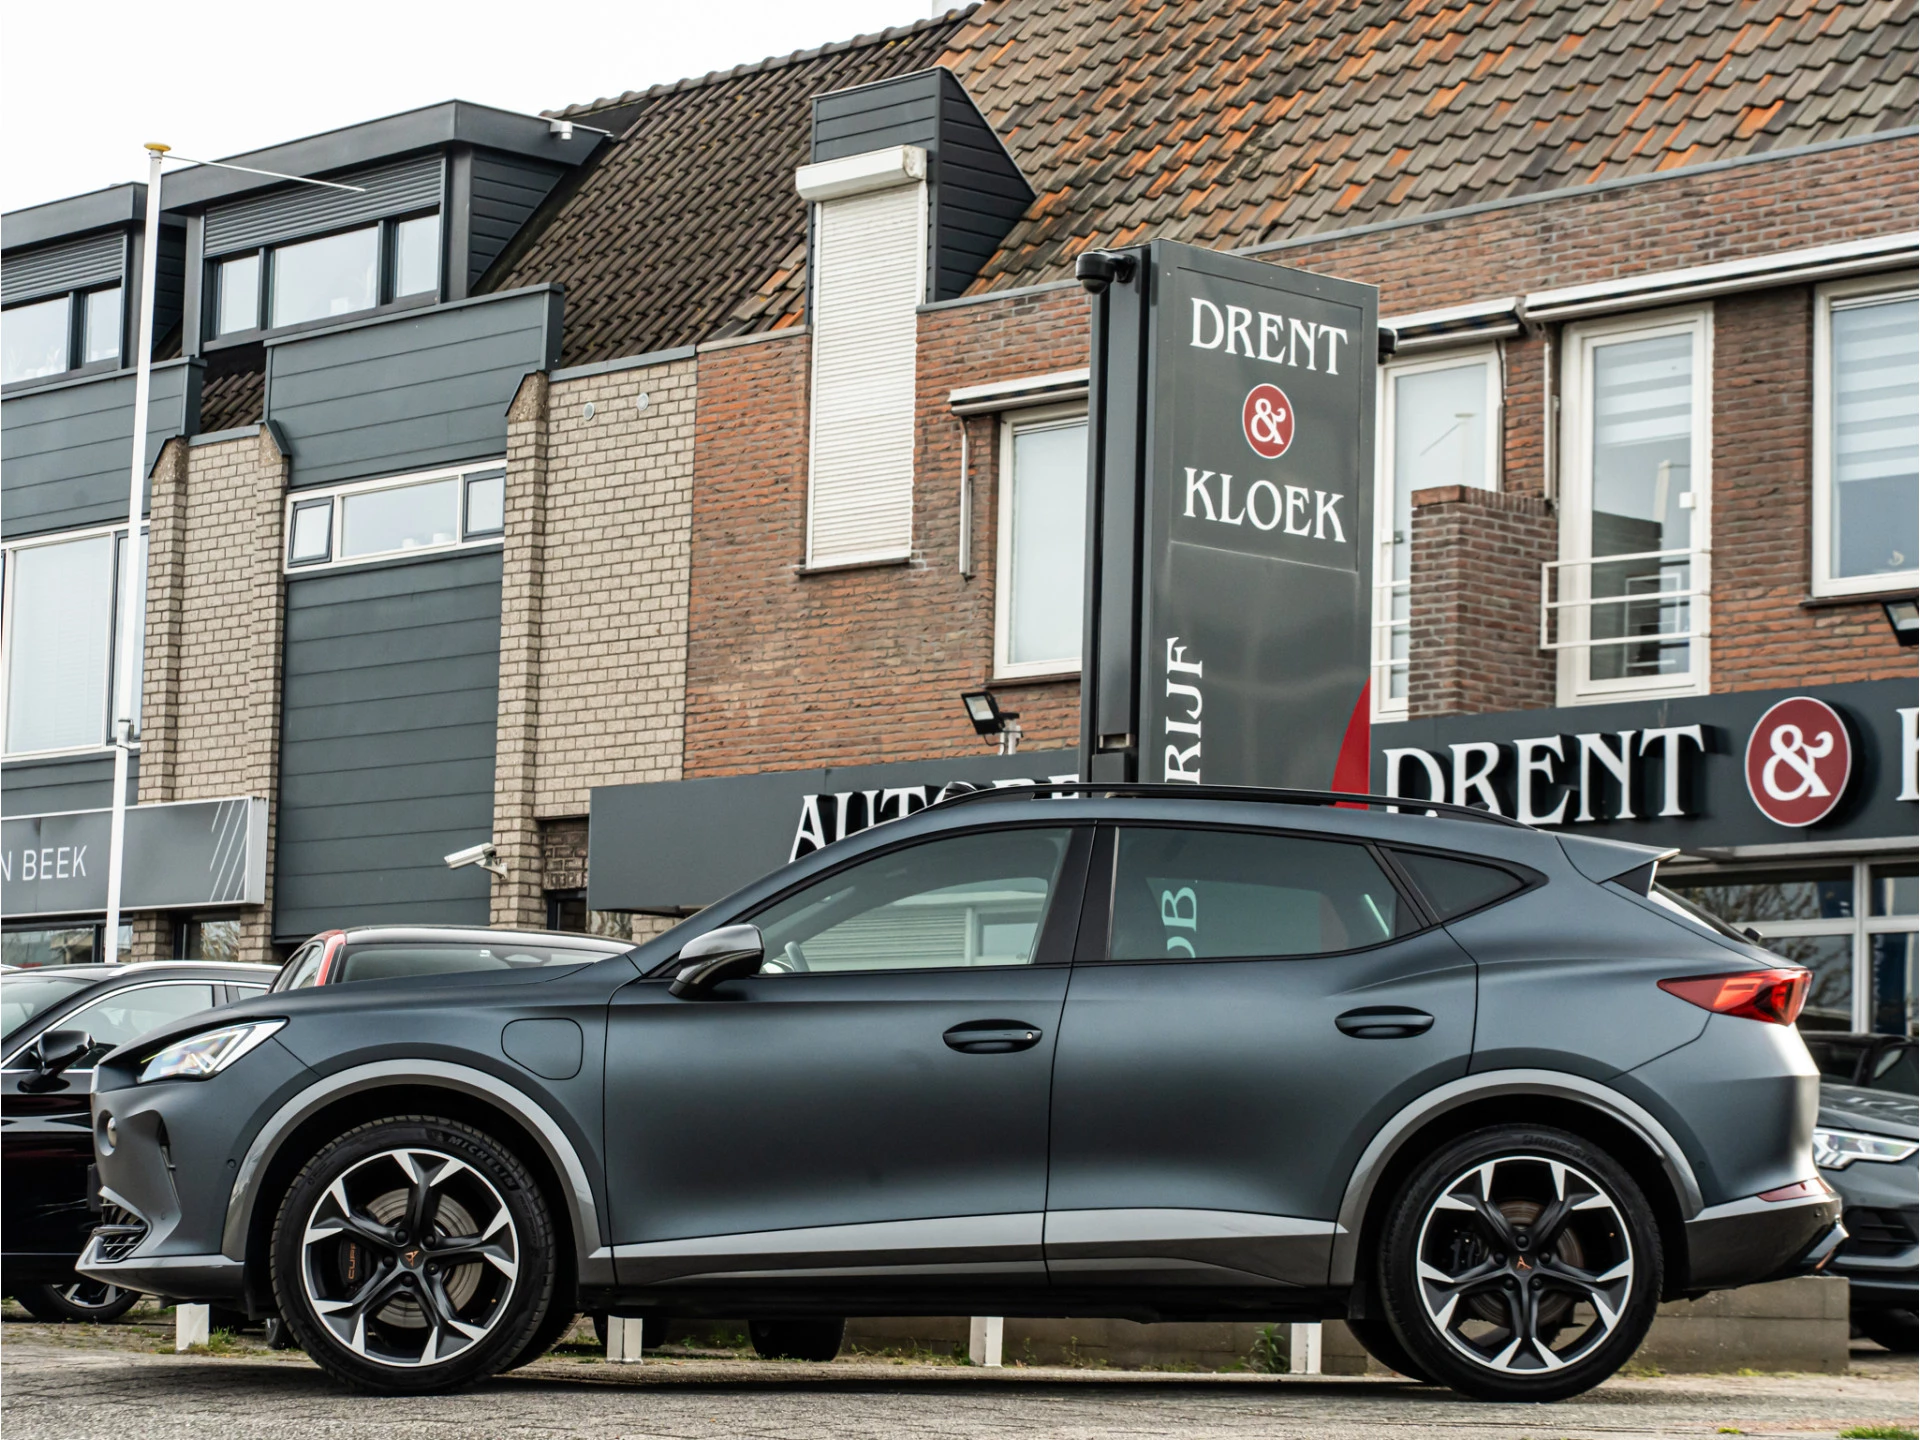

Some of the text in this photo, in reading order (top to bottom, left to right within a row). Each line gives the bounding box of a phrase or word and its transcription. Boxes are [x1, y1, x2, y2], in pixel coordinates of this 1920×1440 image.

[1190, 297, 1348, 375] DRENT
[1250, 397, 1286, 445] &
[1183, 466, 1346, 543] KLOEK
[1382, 724, 1705, 824] DRENT
[1762, 723, 1834, 801] &
[22, 844, 88, 882] BEEK
[447, 1136, 518, 1191] MICHELIN
